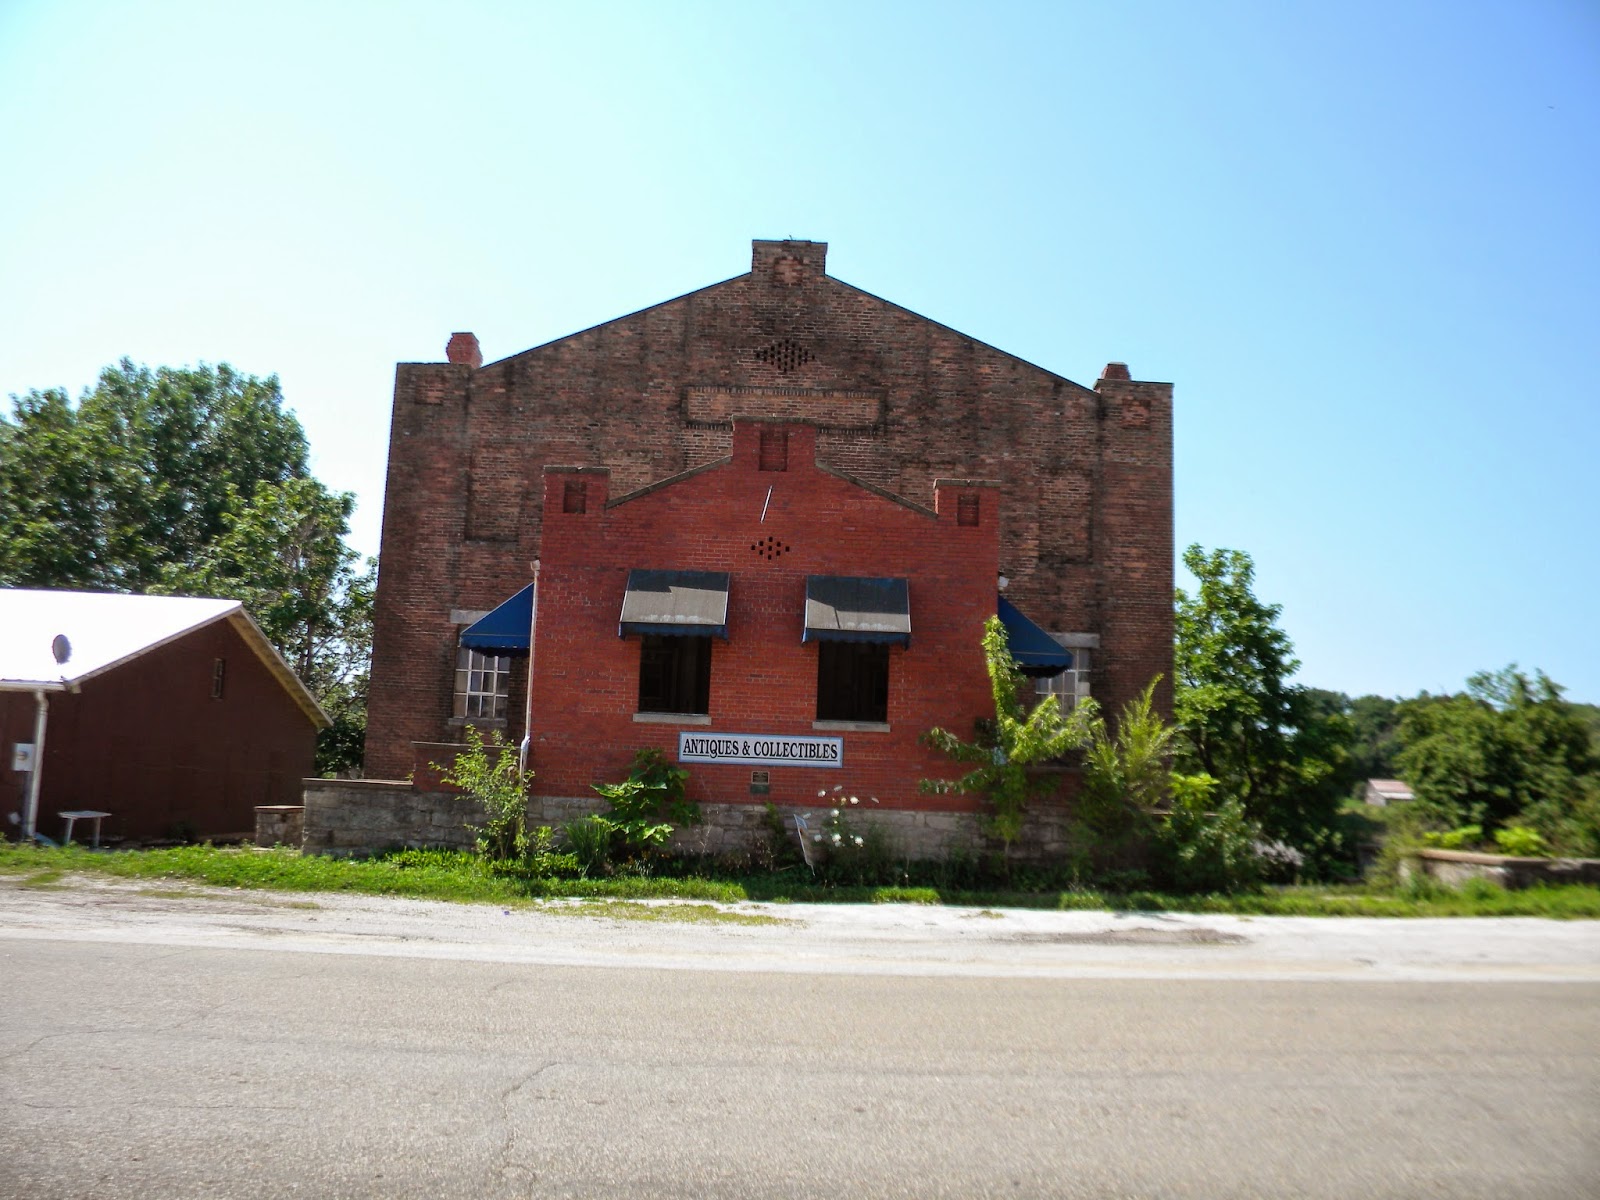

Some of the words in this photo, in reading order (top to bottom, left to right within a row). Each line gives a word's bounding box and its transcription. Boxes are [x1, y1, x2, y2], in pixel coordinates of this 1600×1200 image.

[683, 738, 739, 758] ANTIQUES
[742, 740, 751, 756] &
[753, 741, 838, 759] COLLECTIBLES
